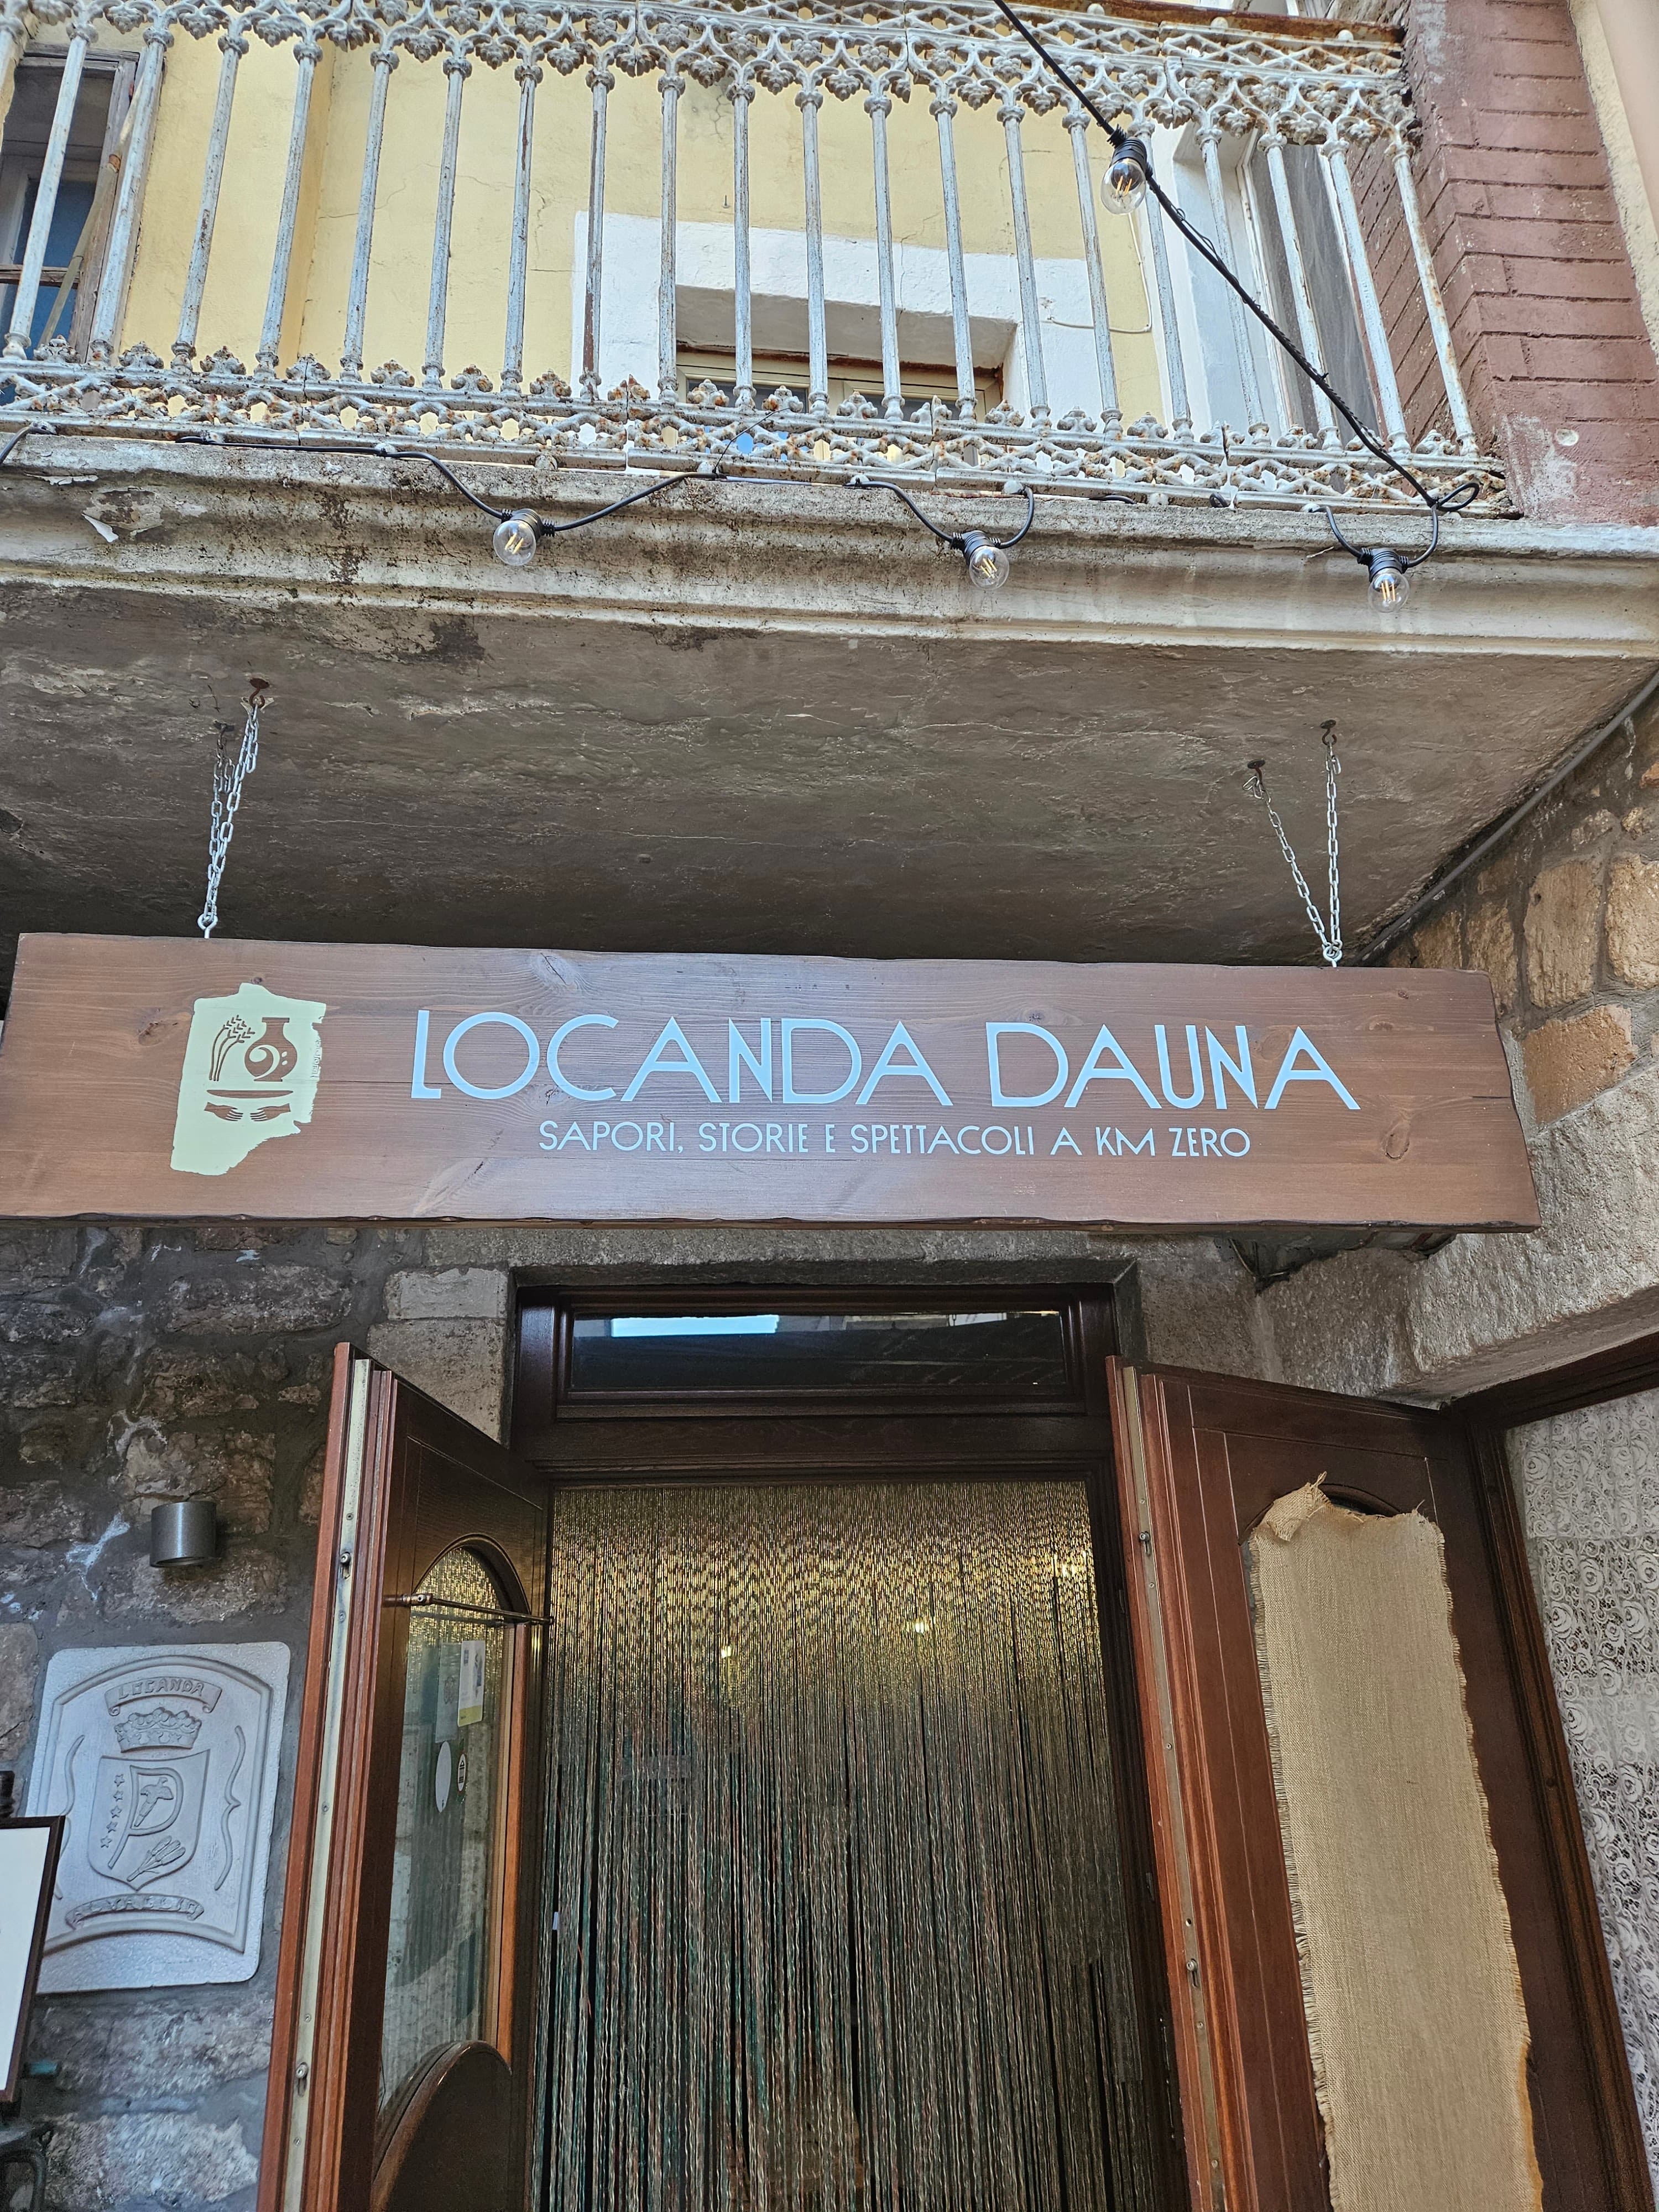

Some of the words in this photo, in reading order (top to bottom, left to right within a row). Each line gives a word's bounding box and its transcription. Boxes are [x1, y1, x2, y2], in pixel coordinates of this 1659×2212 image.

[411, 1009, 953, 1106] LOCANDA
[985, 1021, 1361, 1110] DAUNA
[539, 1120, 684, 1154] SAPORI,
[699, 1122, 808, 1154] STORIE
[826, 1124, 836, 1154] E
[851, 1124, 1034, 1155] SPETTACOLI
[1050, 1126, 1082, 1156] A
[1096, 1126, 1156, 1156] KM
[1168, 1128, 1250, 1157] ZERO
